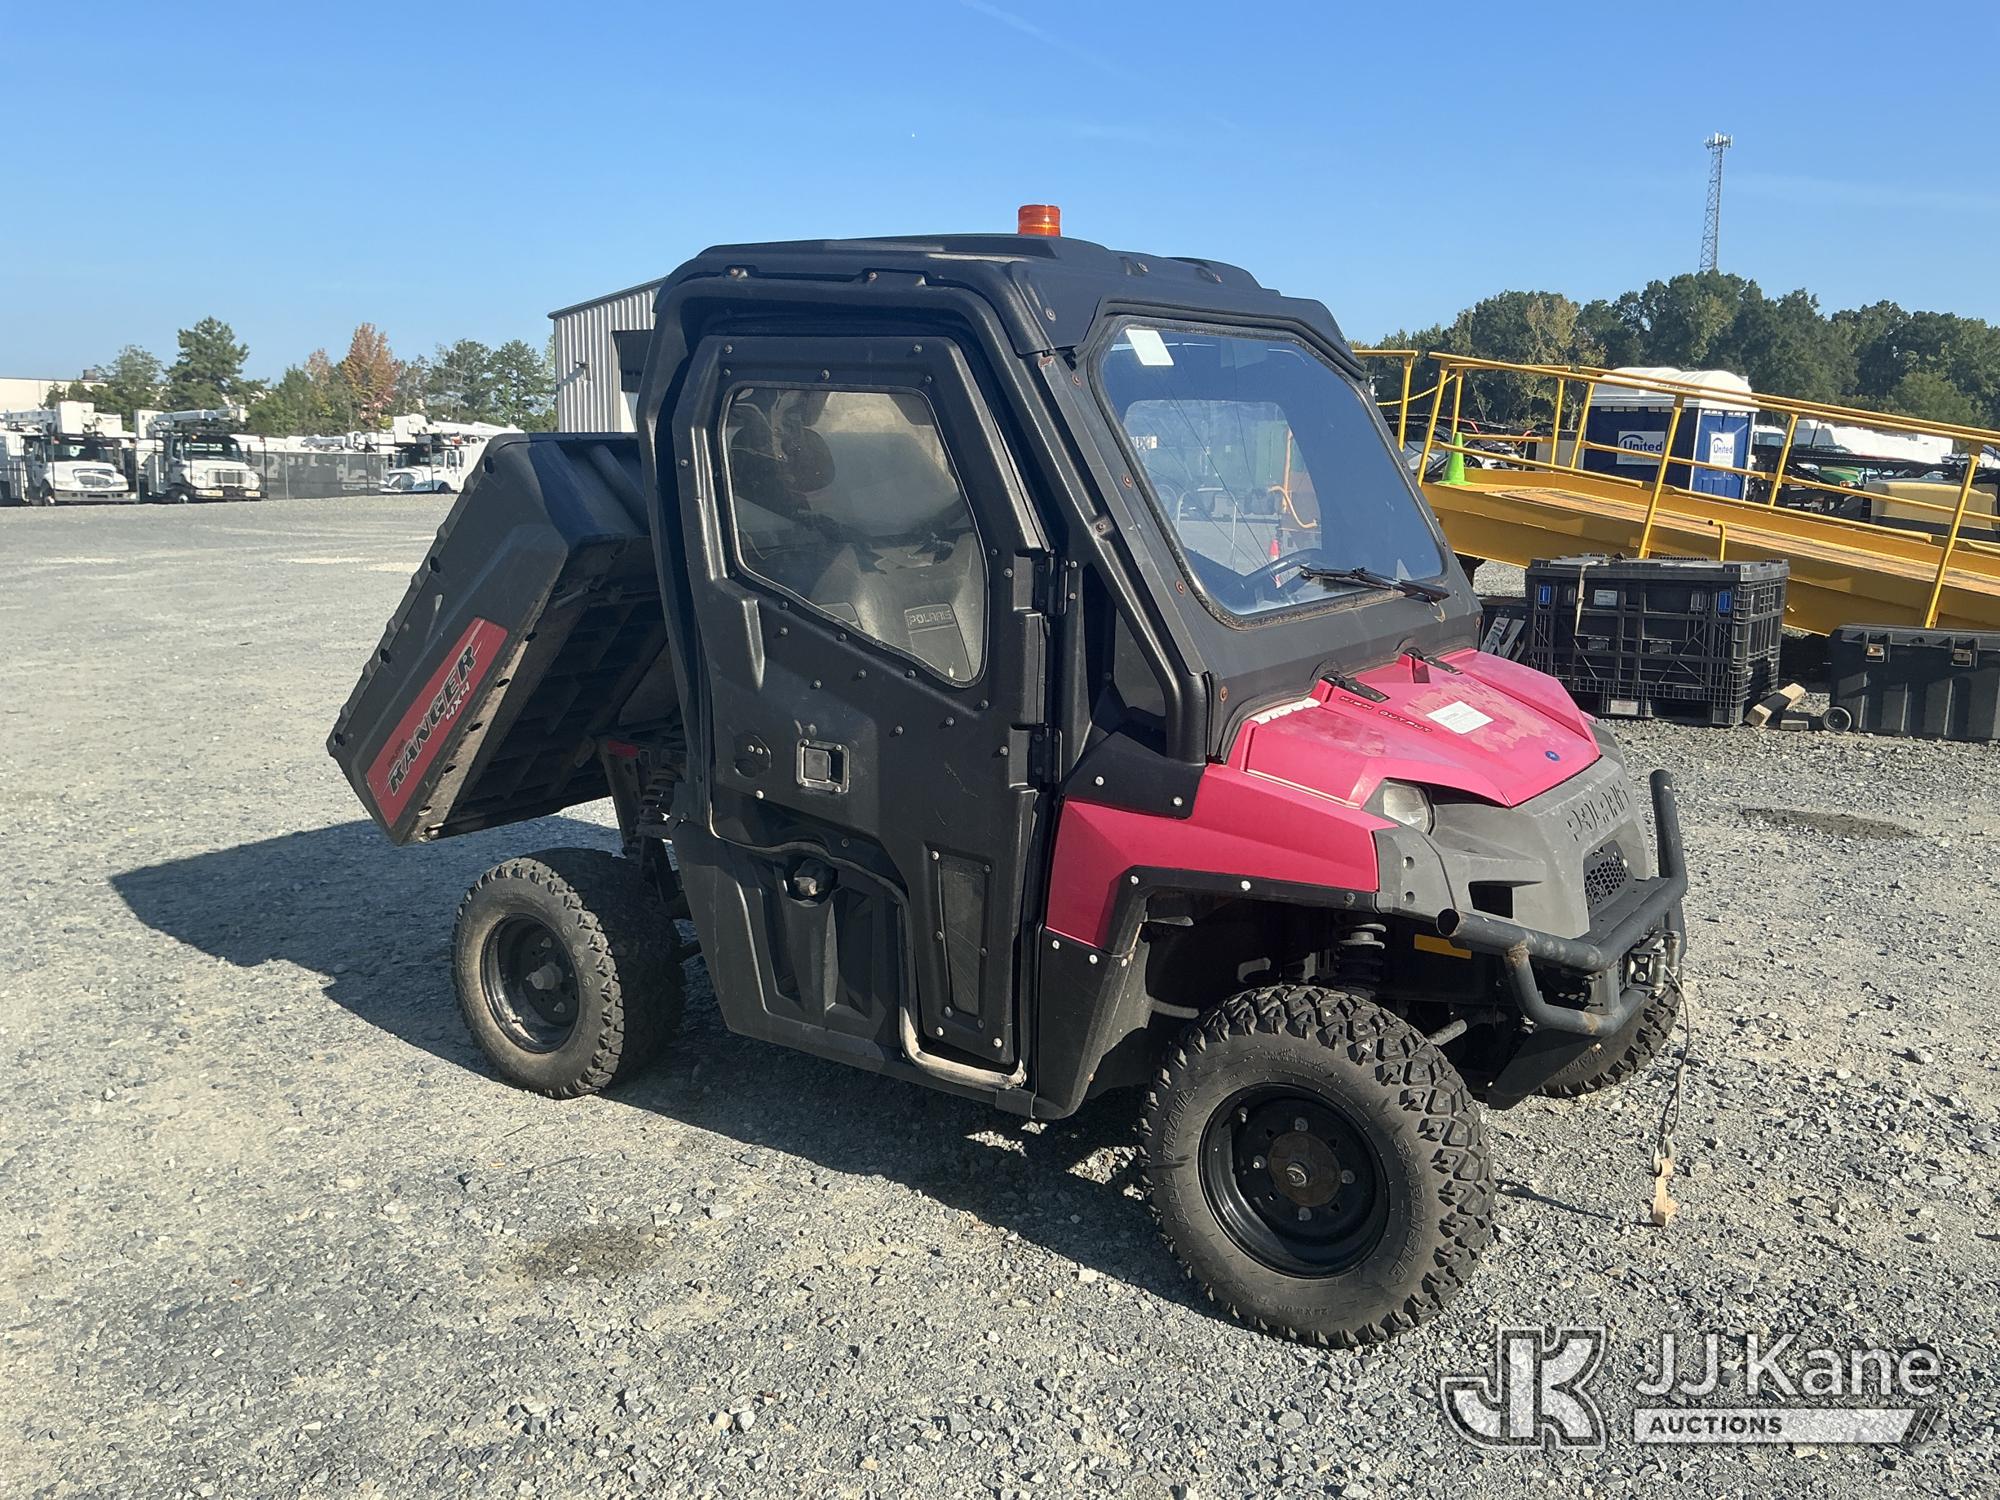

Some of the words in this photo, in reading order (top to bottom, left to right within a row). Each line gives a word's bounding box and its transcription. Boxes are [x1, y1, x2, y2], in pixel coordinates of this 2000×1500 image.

[1623, 440, 1663, 452] United
[1713, 444, 1733, 454] United
[910, 610, 953, 625] POLARIS
[388, 645, 477, 796] RANGER
[1339, 696, 1375, 710] HIGH
[1378, 709, 1433, 733] OUTPUT
[1162, 1088, 1196, 1160] TRAIL
